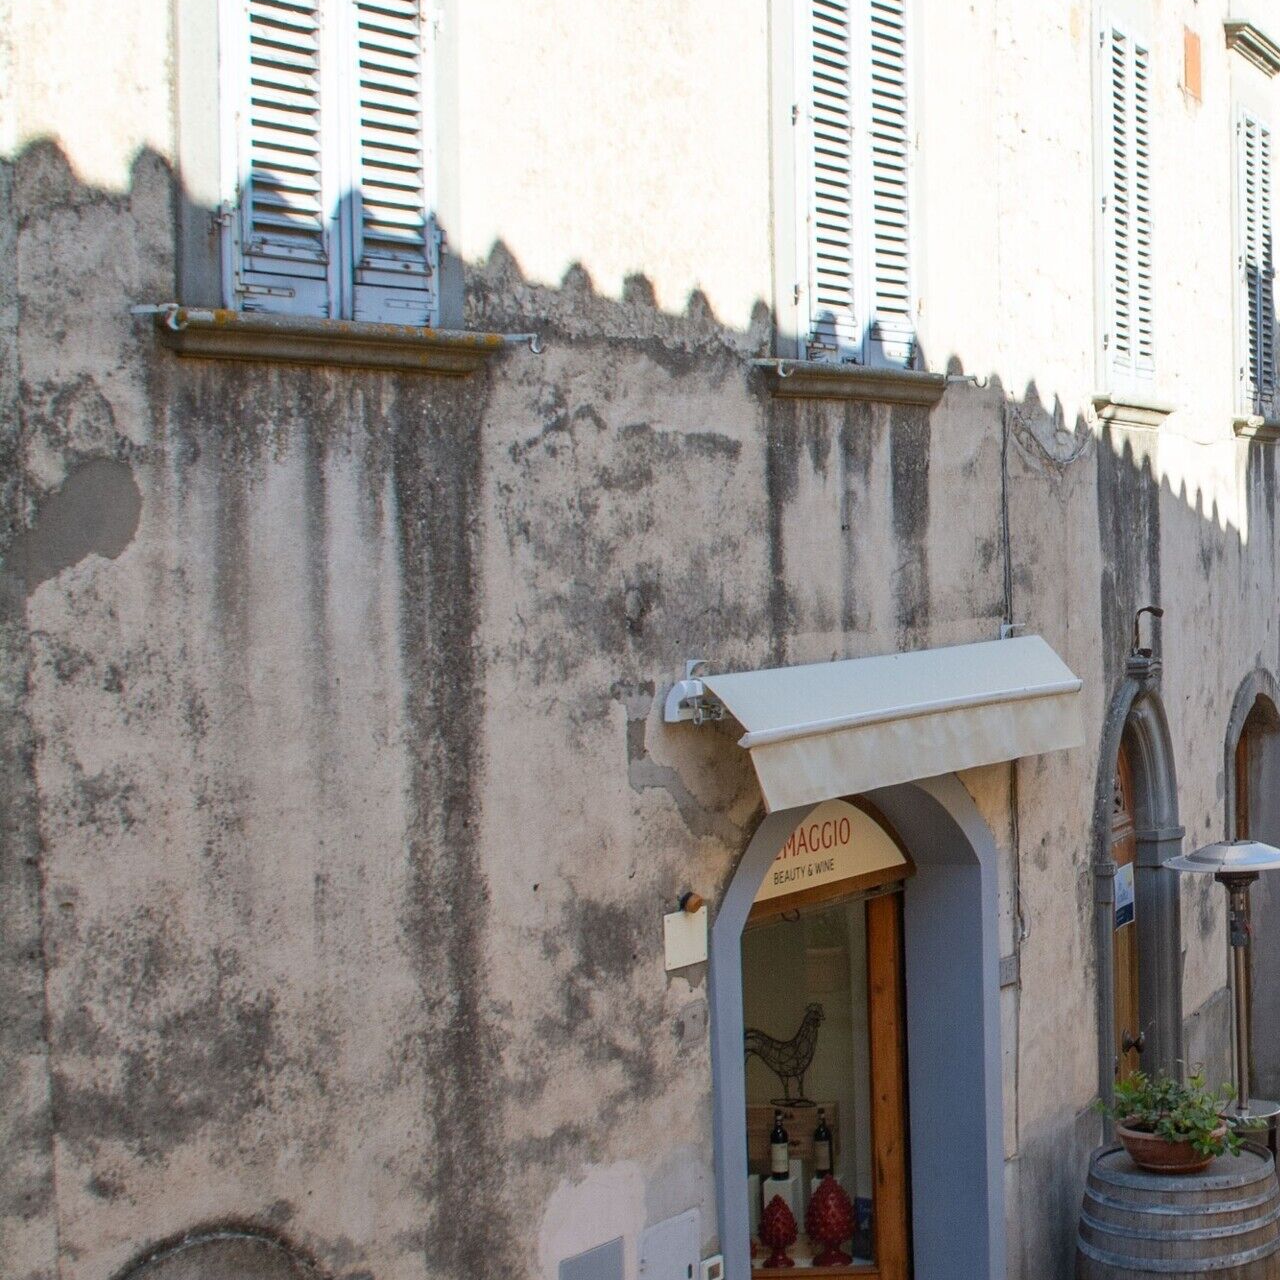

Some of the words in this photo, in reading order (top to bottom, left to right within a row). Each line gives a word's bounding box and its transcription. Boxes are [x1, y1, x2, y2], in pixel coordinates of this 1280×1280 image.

[776, 817, 851, 861] MAGGIO
[773, 864, 806, 885] BEAUTY
[807, 863, 813, 877] &
[815, 858, 835, 875] WINE
